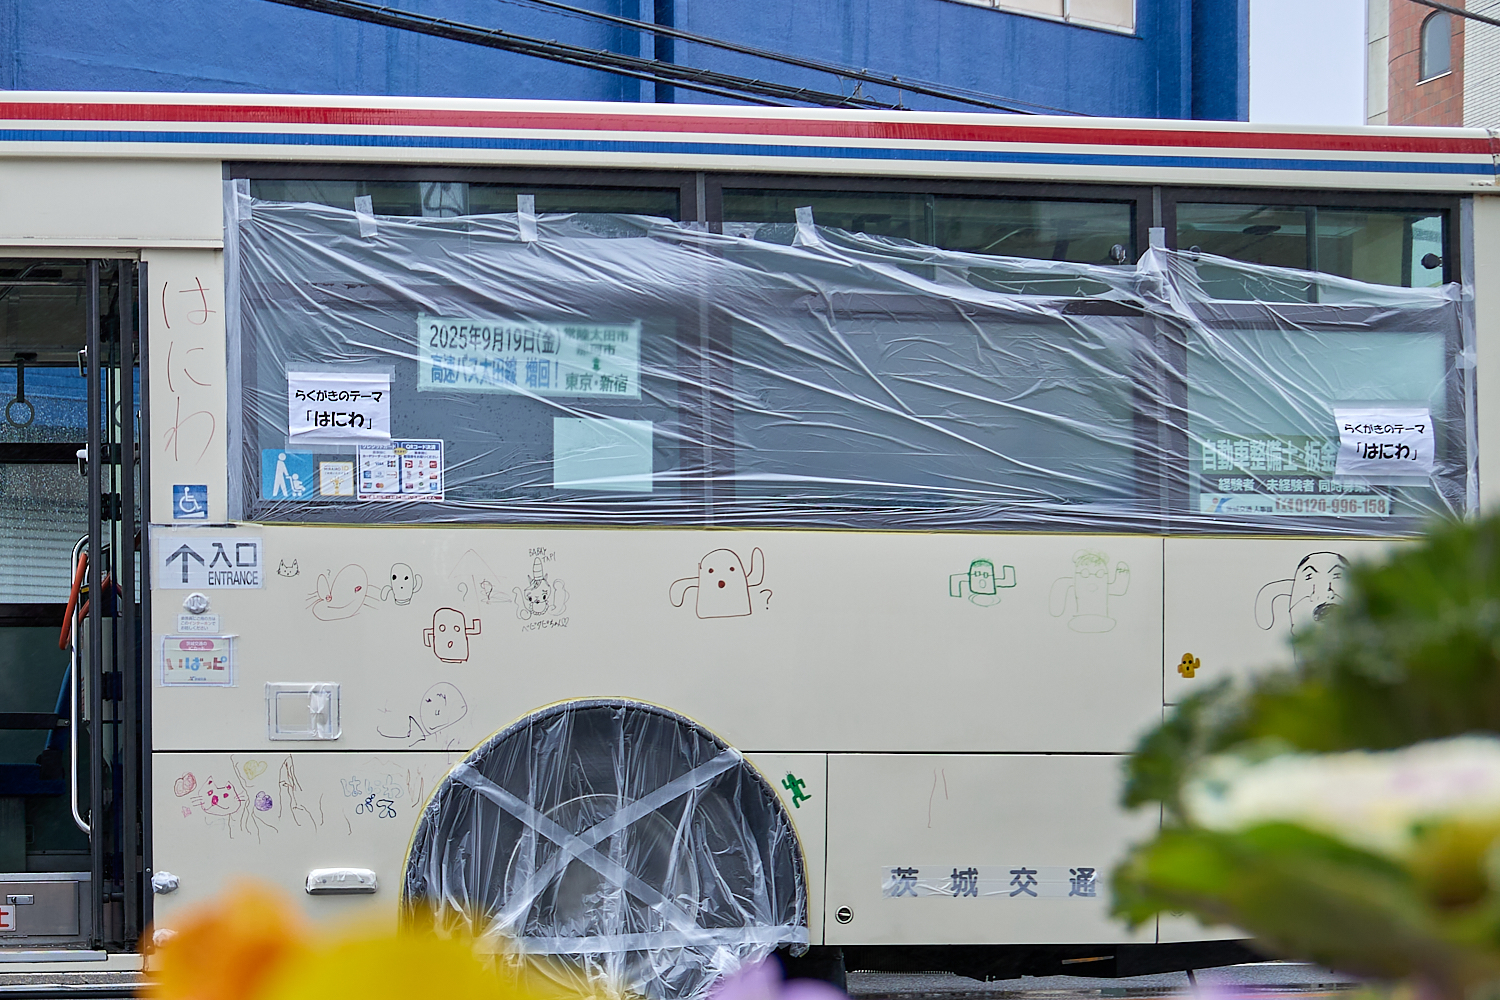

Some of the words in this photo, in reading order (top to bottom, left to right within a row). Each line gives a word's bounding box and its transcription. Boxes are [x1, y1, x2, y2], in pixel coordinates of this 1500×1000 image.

[162, 276, 217, 466] はにわ
[565, 372, 629, 393] 東京・新宿
[295, 389, 383, 402] らくがきのテーマ
[306, 410, 372, 430] 「はにわ」
[1344, 424, 1425, 434] らくがきのテーマ
[1202, 440, 1341, 473] 自動車整備士・板金
[1357, 442, 1418, 460] 「はにわ」
[1295, 498, 1386, 514] 0120-996-158
[209, 543, 257, 568] 入口
[208, 571, 258, 585] ENTRANCE
[165, 656, 228, 671] いばっピ
[890, 866, 1097, 898] 茨城交通
